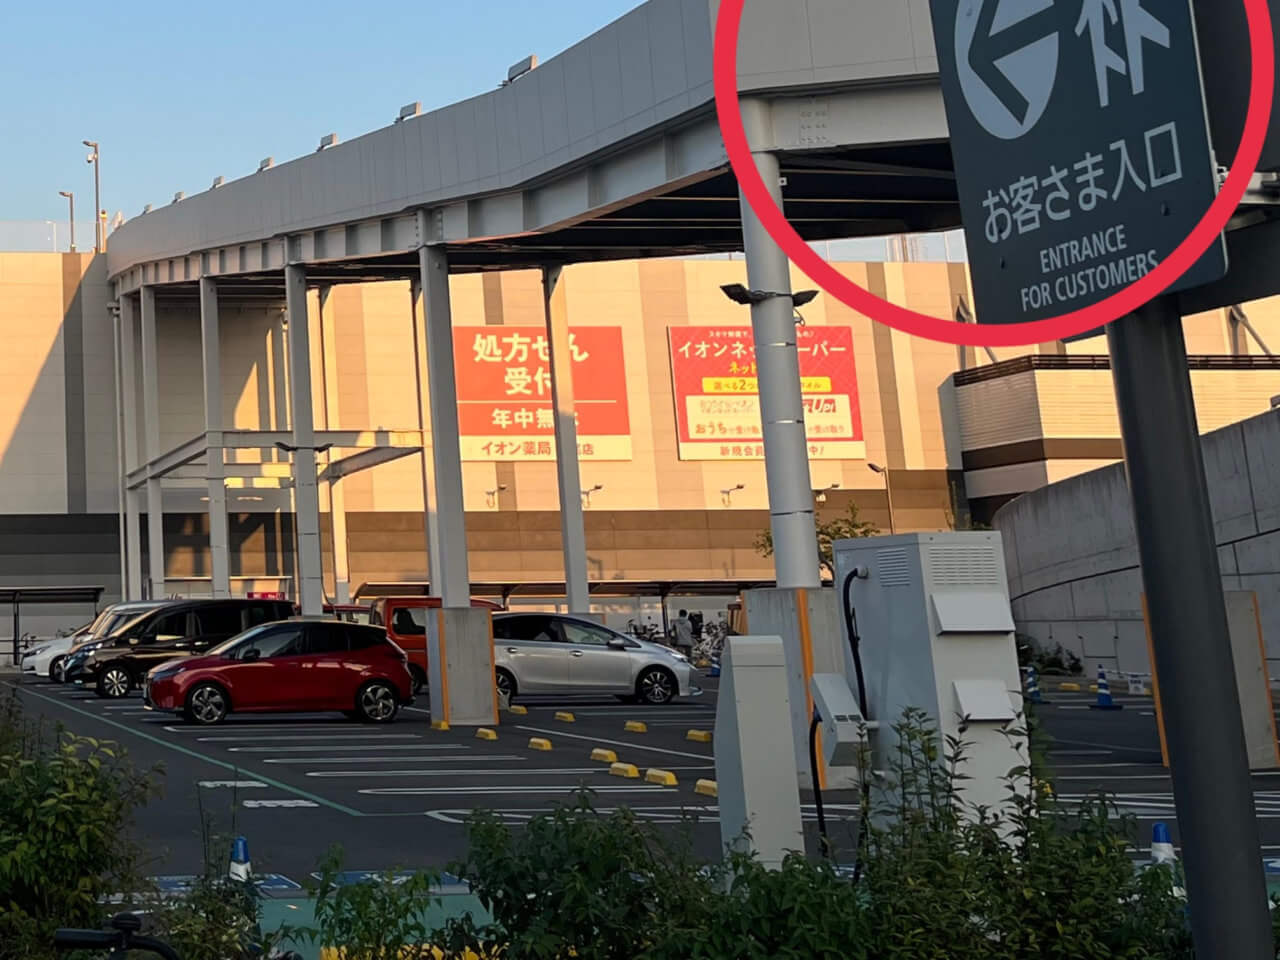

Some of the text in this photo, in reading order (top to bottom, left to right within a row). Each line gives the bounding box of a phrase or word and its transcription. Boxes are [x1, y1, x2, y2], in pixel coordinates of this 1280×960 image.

[982, 121, 1183, 244] お客さま入口
[1039, 224, 1128, 273] ENTRANCE
[1021, 249, 1159, 312] FOR CUSTOMERS
[492, 408, 579, 429] 年中無
